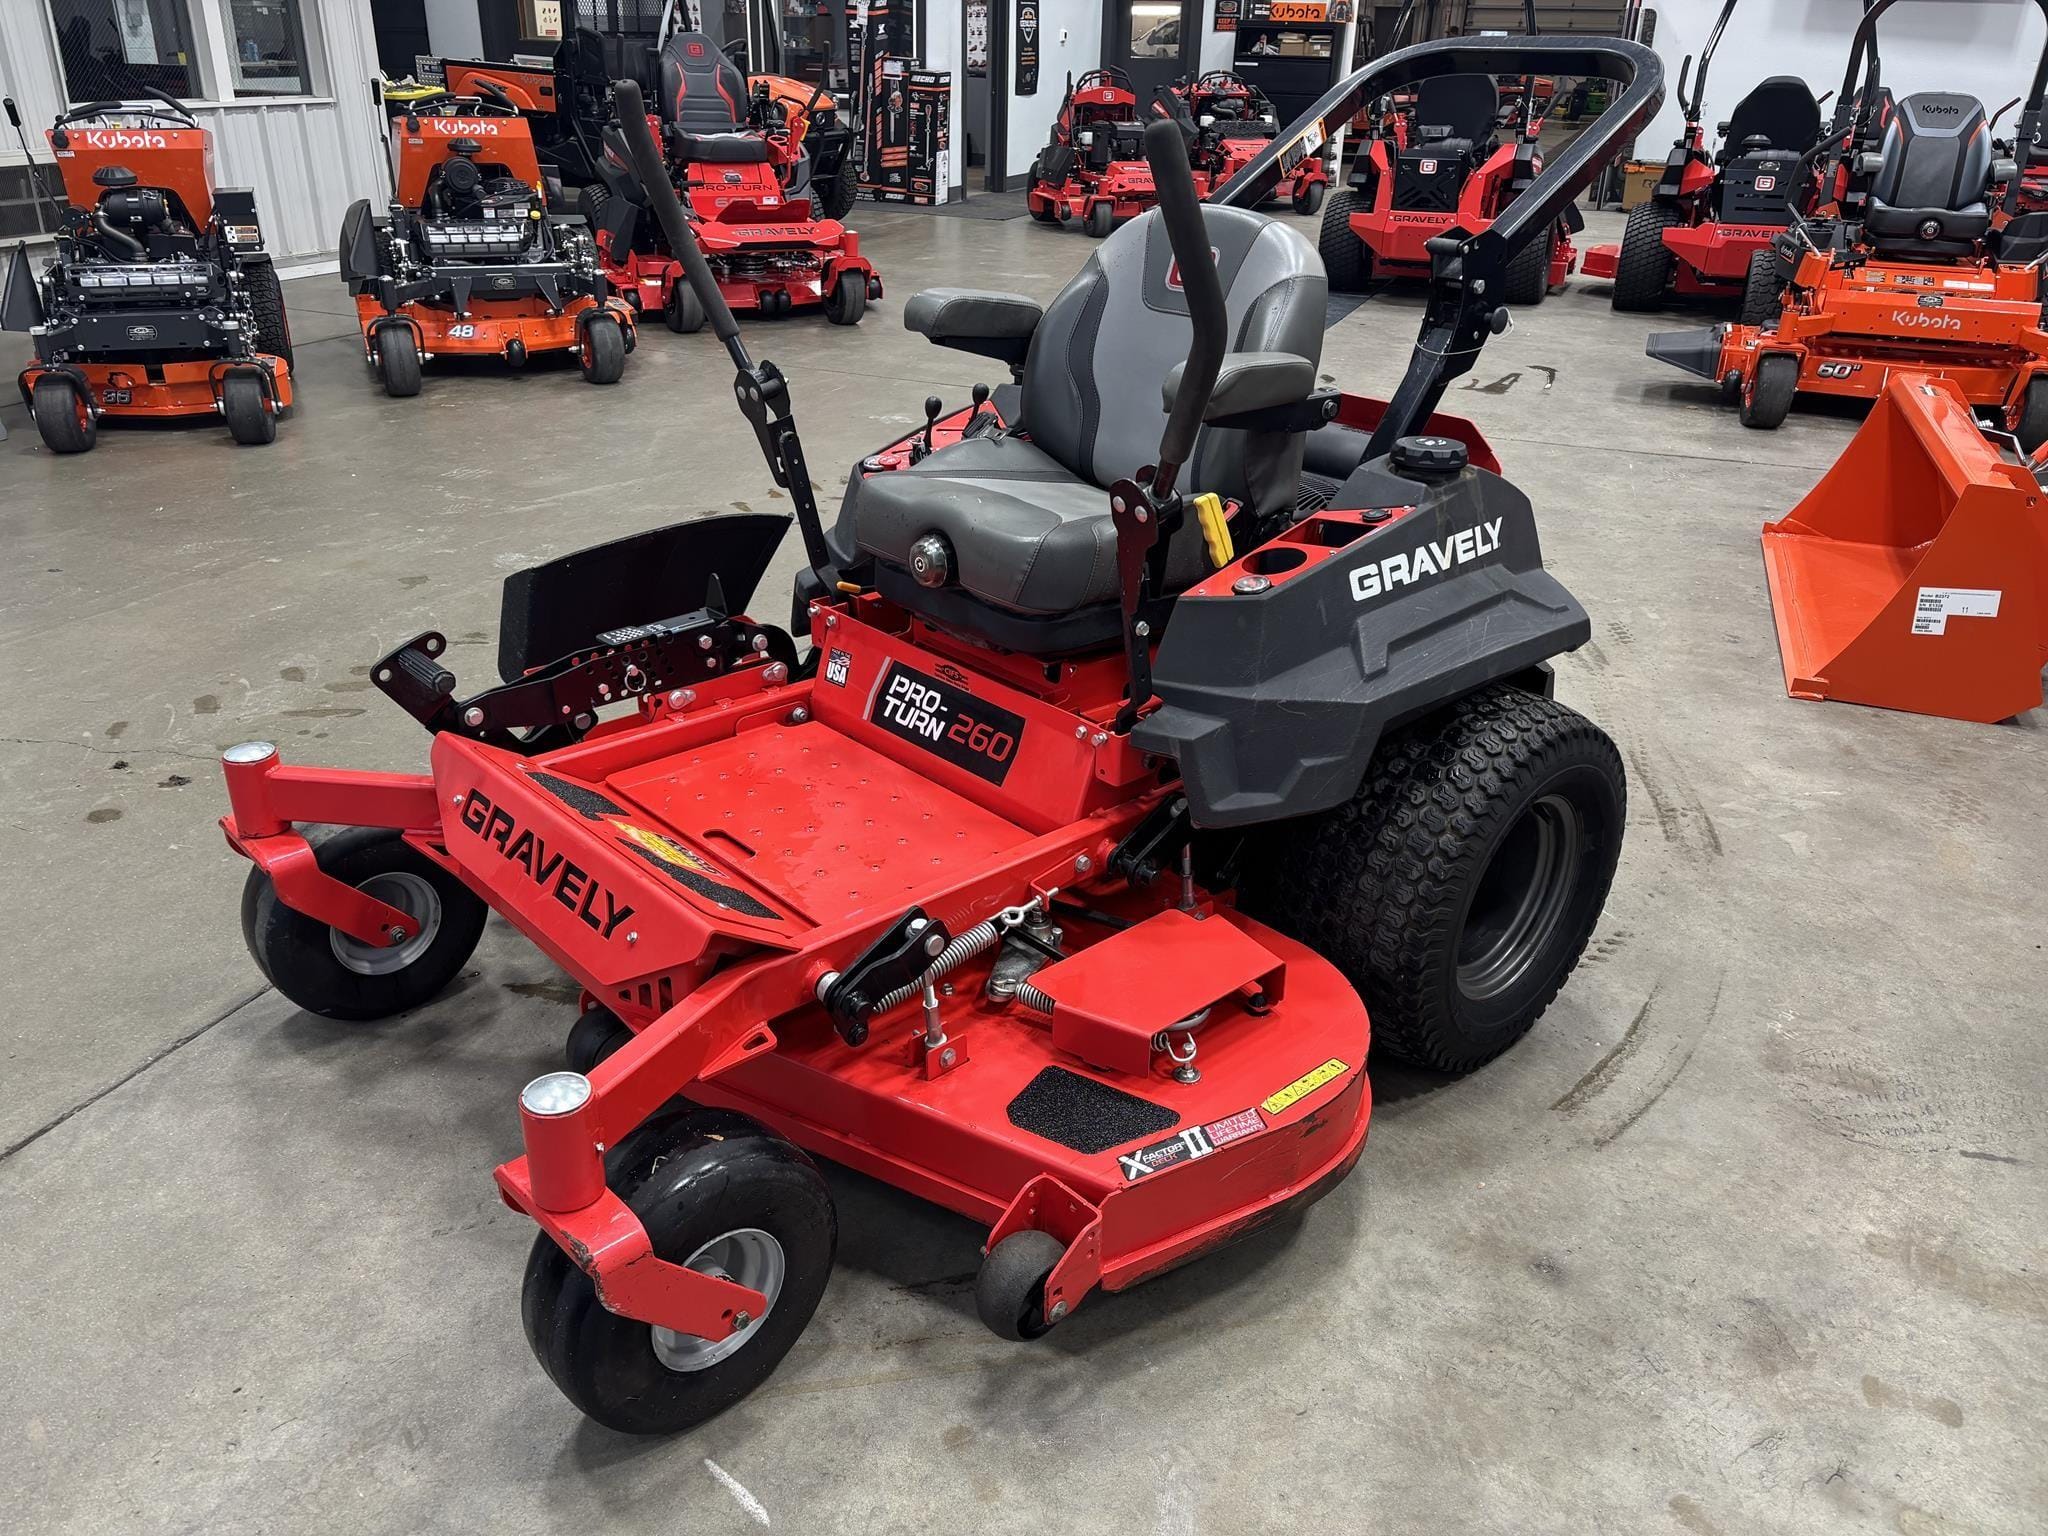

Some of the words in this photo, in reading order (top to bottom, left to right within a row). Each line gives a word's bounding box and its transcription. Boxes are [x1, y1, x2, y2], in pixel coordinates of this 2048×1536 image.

[1270, 3, 1321, 19] Kubota
[1922, 104, 1959, 115] Kubota
[433, 119, 498, 136] Kubota
[86, 131, 166, 149] Kubota
[695, 184, 773, 192] PRO-TURN
[1393, 214, 1449, 225] GRAVELY
[736, 226, 815, 237] GRAVELY
[1891, 310, 1961, 330] Kubota
[448, 324, 475, 339] 48
[103, 389, 132, 404] 36
[1349, 516, 1504, 602] GRAVELY
[826, 661, 847, 684] USA
[889, 674, 949, 714] PRO-
[883, 696, 946, 742] TURN
[947, 713, 1014, 763] 260
[460, 787, 636, 941] GRAVELY
[1205, 1108, 1258, 1134] LIMITED
[1209, 1116, 1261, 1139] LIFETIME
[1213, 1122, 1265, 1145] WARRANTY
